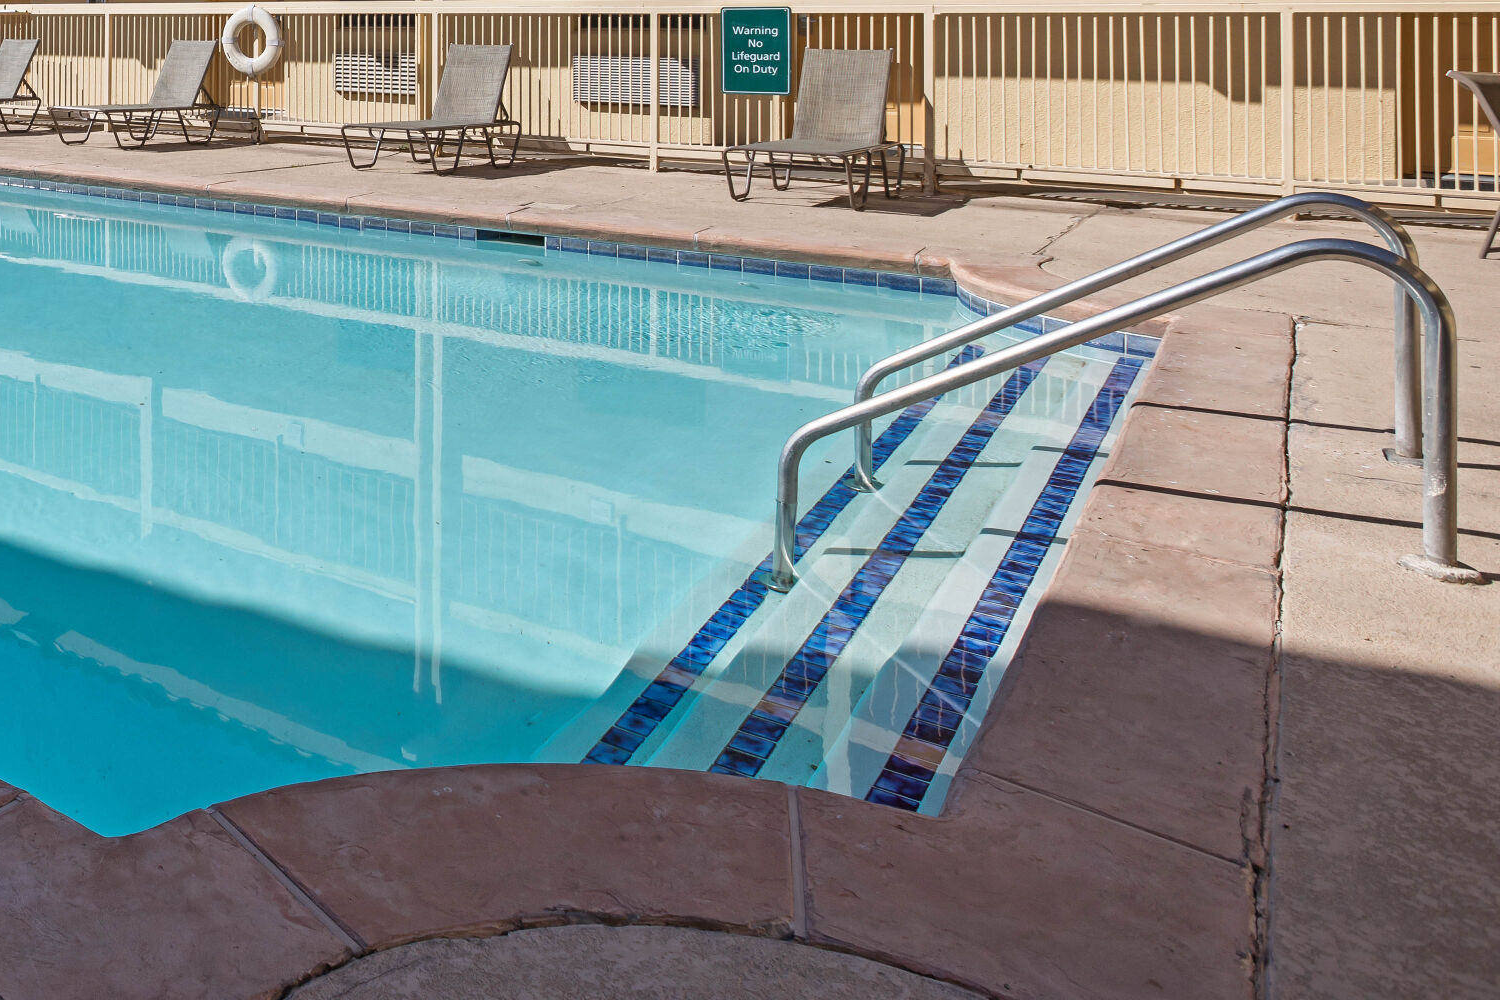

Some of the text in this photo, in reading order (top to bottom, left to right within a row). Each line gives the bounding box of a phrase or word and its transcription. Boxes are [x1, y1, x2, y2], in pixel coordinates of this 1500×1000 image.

[732, 26, 779, 37] Warning
[748, 39, 763, 48] No
[731, 51, 780, 63] Lifeguard
[734, 64, 778, 76] On Duty
